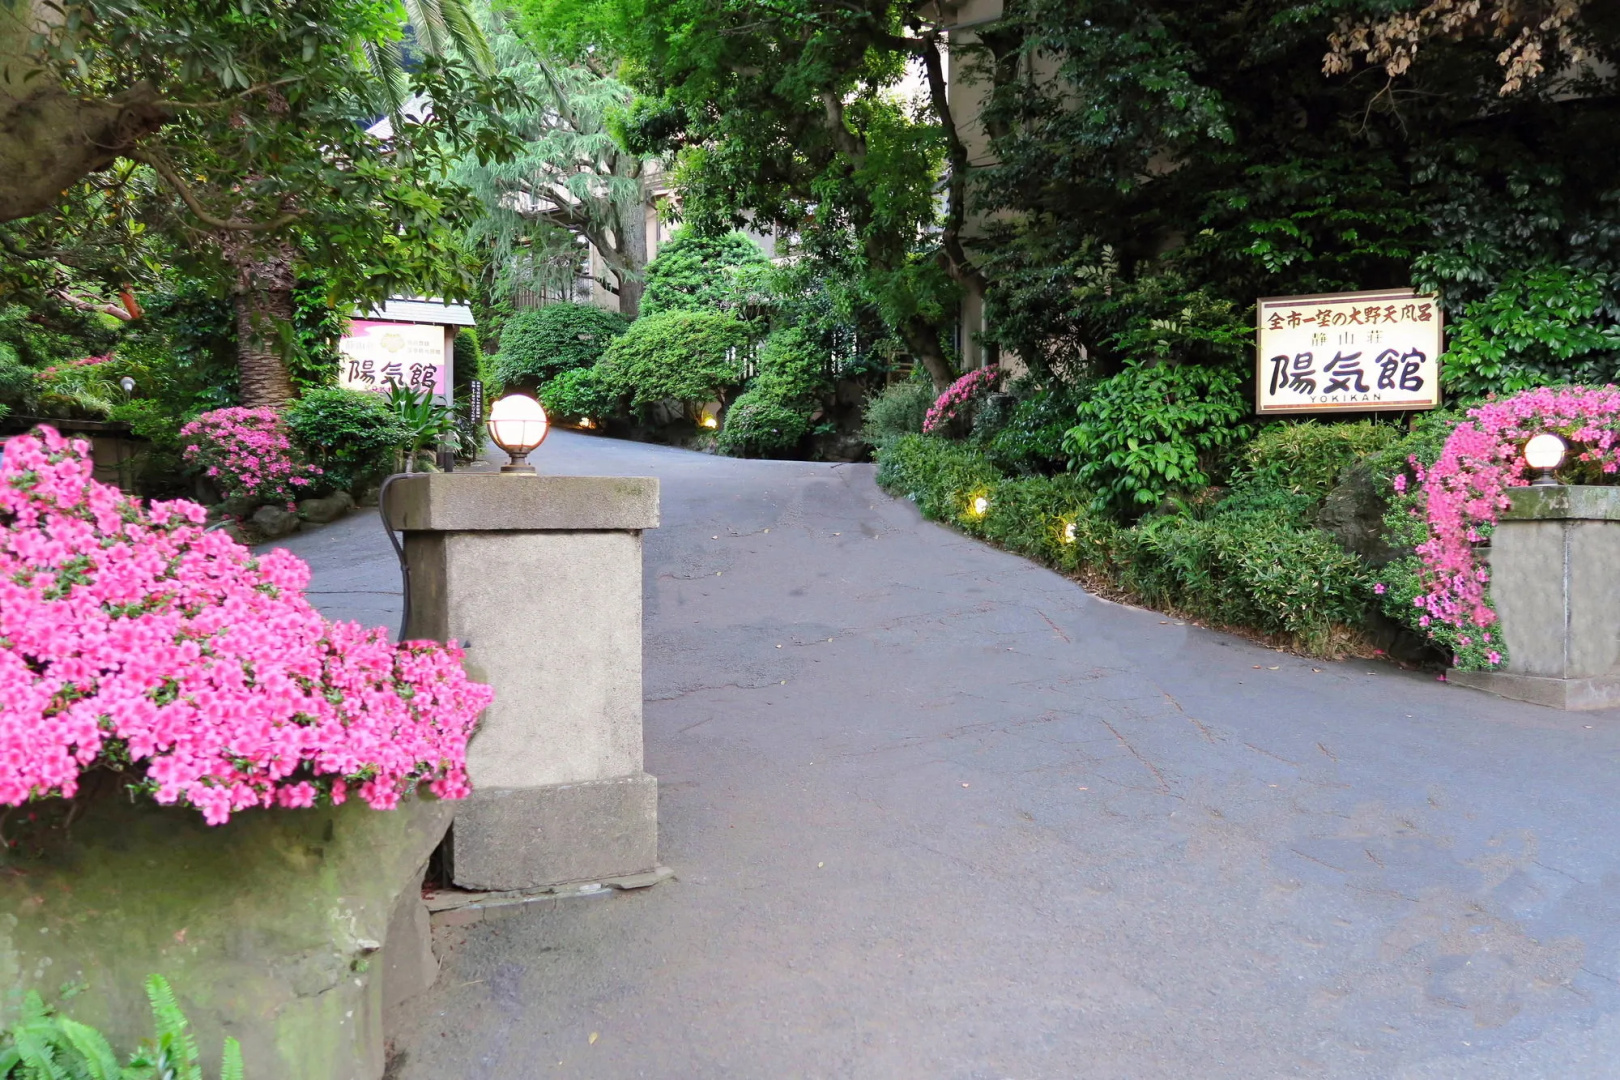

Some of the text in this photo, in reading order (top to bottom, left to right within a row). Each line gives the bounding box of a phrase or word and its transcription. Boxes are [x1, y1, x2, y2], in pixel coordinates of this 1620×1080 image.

[1267, 303, 1433, 331] 全市一望の大野天風呂
[347, 359, 438, 388] 陽気館
[1269, 347, 1427, 396] 陽気館
[1310, 393, 1382, 404] YOKIKAN
